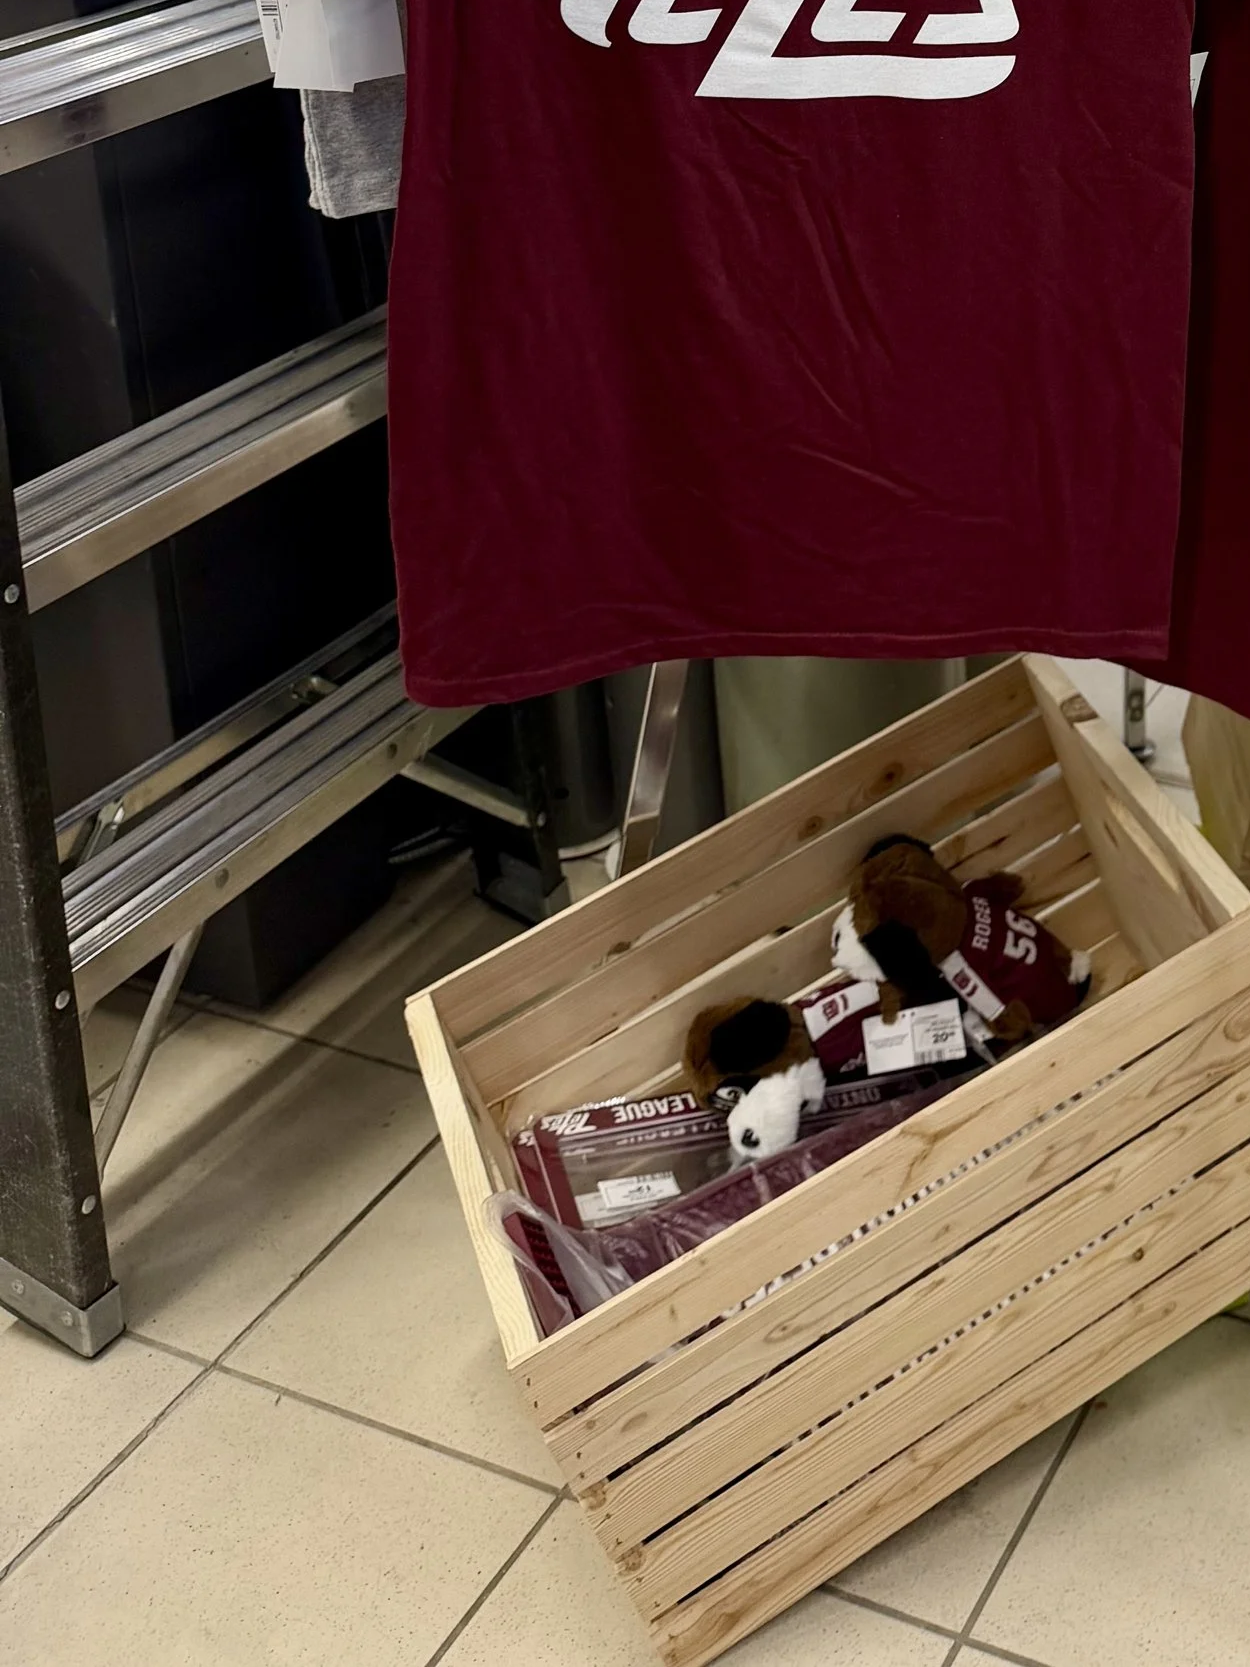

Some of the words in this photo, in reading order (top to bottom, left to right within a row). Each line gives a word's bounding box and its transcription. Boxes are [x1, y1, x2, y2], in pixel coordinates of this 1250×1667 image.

[972, 896, 992, 951] ROGER
[1003, 909, 1038, 966] 56
[613, 1092, 698, 1124] LEAGUE
